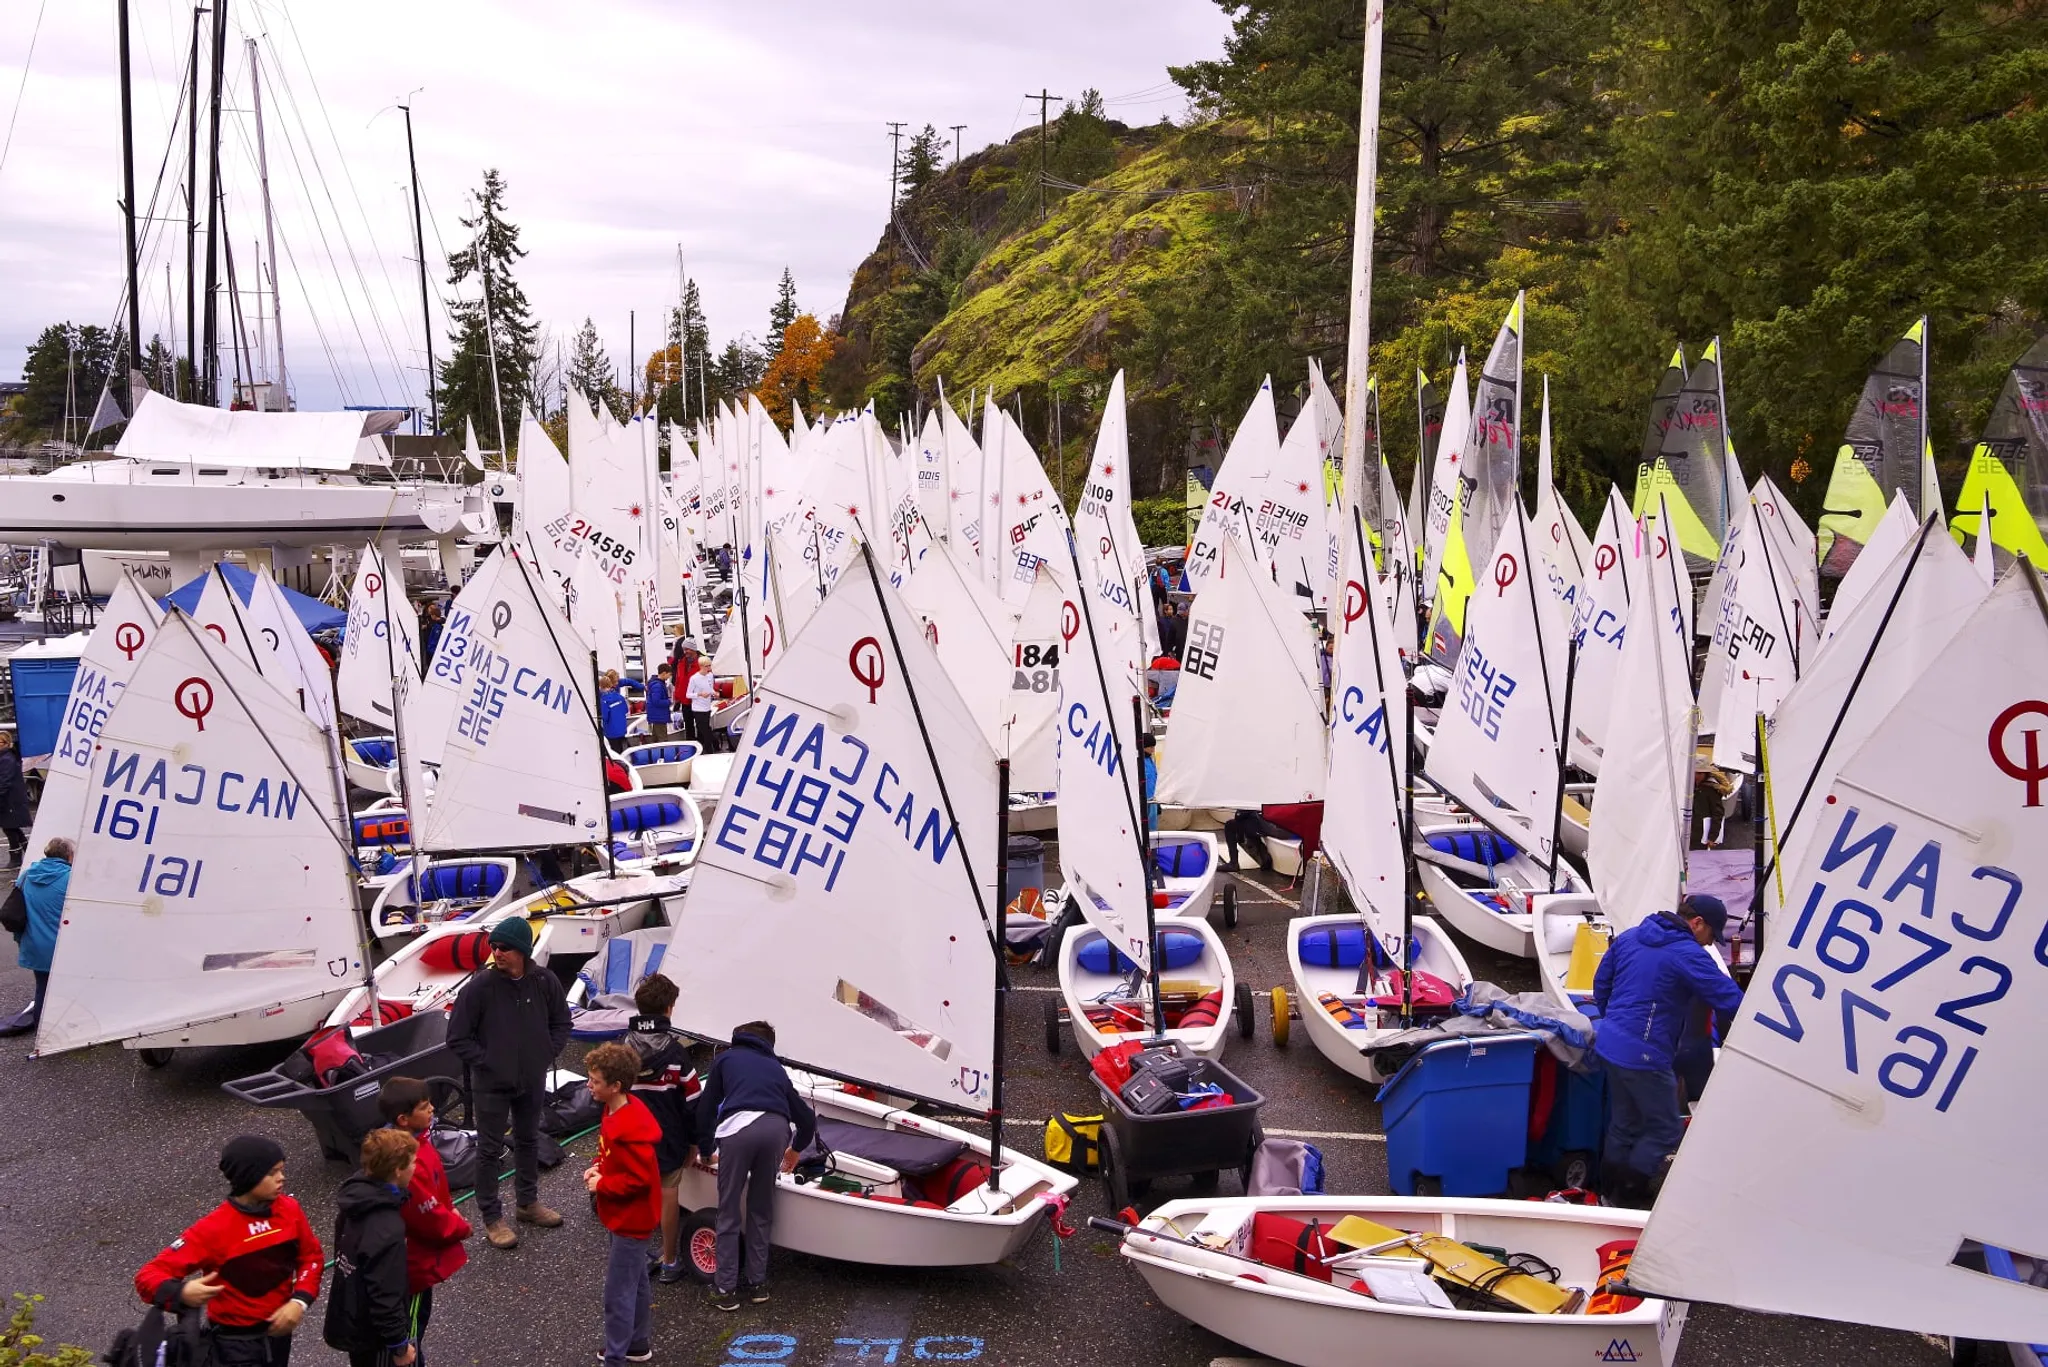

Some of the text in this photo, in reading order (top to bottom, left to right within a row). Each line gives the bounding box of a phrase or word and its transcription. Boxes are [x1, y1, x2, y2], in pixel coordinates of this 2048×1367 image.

[1087, 484, 1114, 502] 108
[1260, 499, 1309, 527] 213418
[570, 519, 635, 566] 214585
[1015, 643, 1059, 668] 184
[1185, 646, 1219, 681] 82
[470, 677, 508, 719] 315
[513, 667, 572, 715] CAN
[1068, 702, 1119, 777] CAN
[93, 794, 159, 845] 161
[217, 771, 300, 821] CAN
[734, 753, 866, 844] 1483
[874, 762, 955, 865] CAN
[1787, 881, 2014, 1037] 1672
